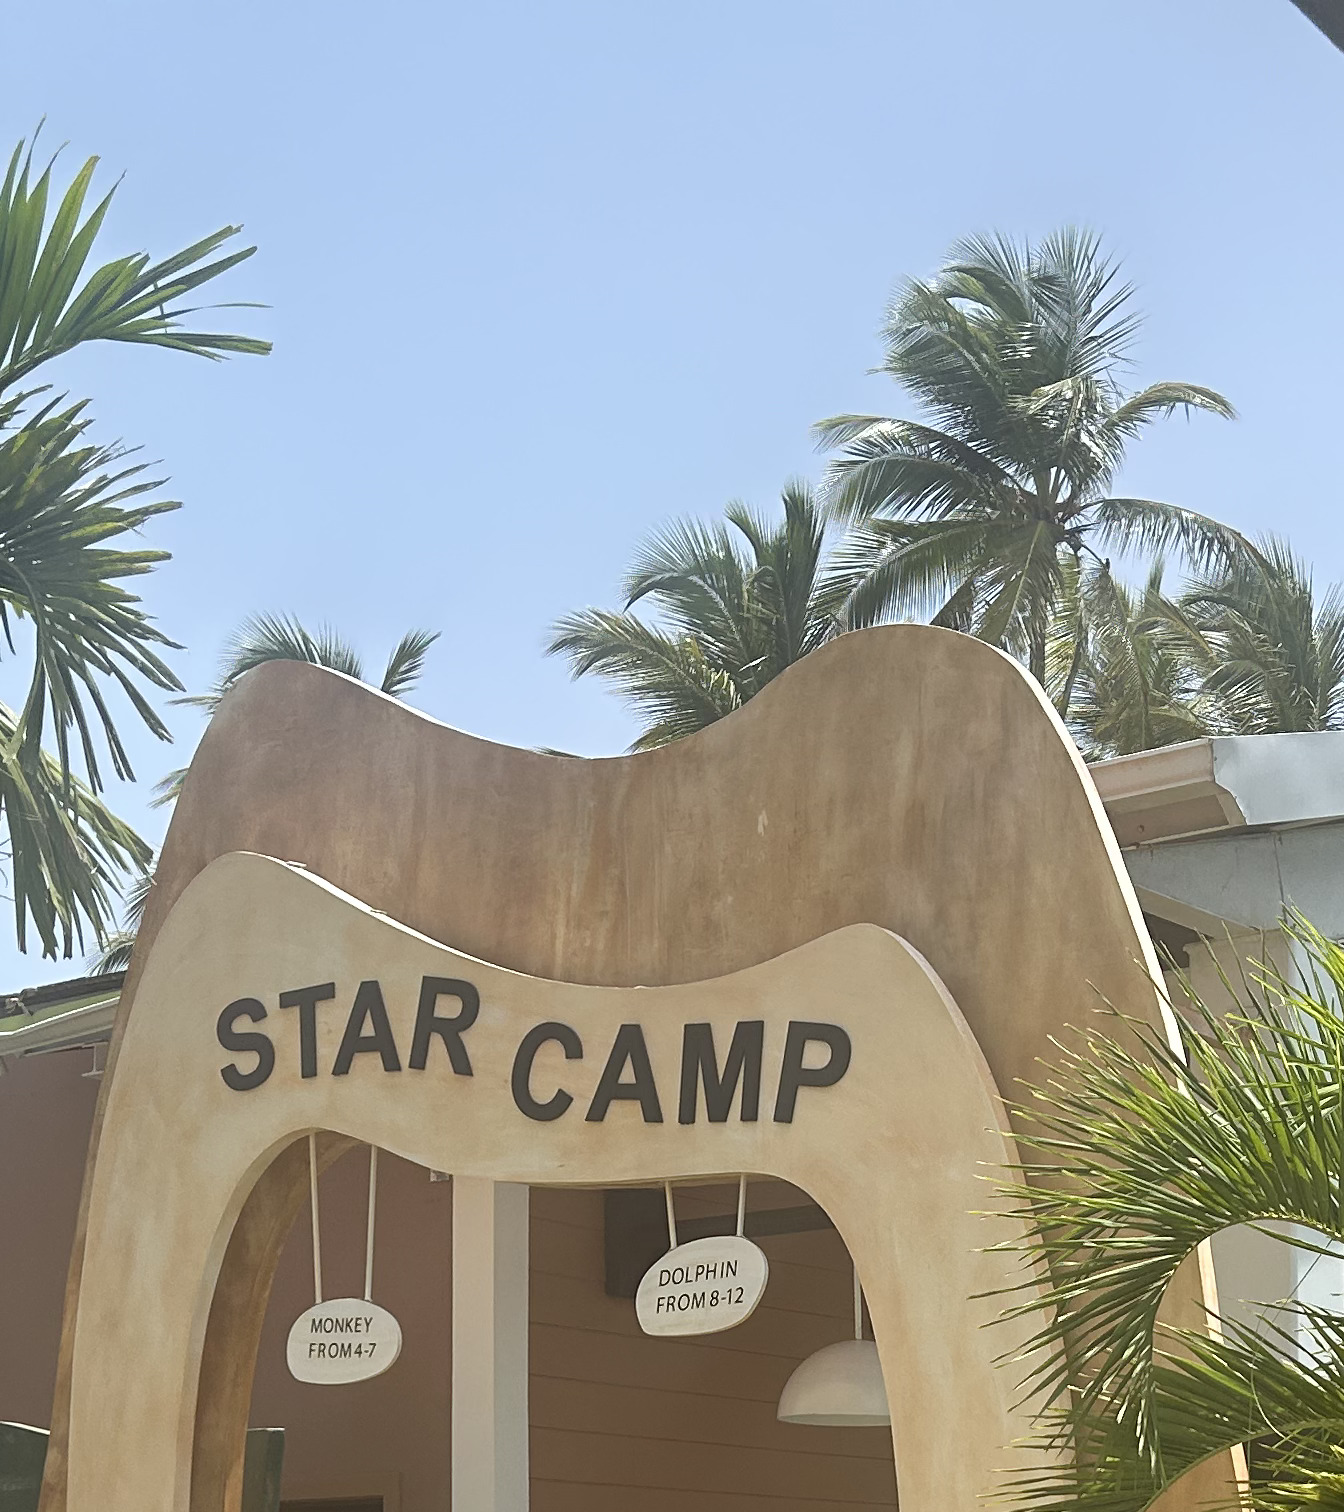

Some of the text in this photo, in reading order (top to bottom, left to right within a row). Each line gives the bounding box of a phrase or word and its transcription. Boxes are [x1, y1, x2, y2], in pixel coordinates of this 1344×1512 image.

[216, 975, 852, 1126] STAR CAMP
[658, 1260, 738, 1287] DOLPHIN
[656, 1287, 745, 1314] FROM 8-12
[310, 1317, 373, 1334] MONKEY
[308, 1343, 377, 1359] FROM 4-7
